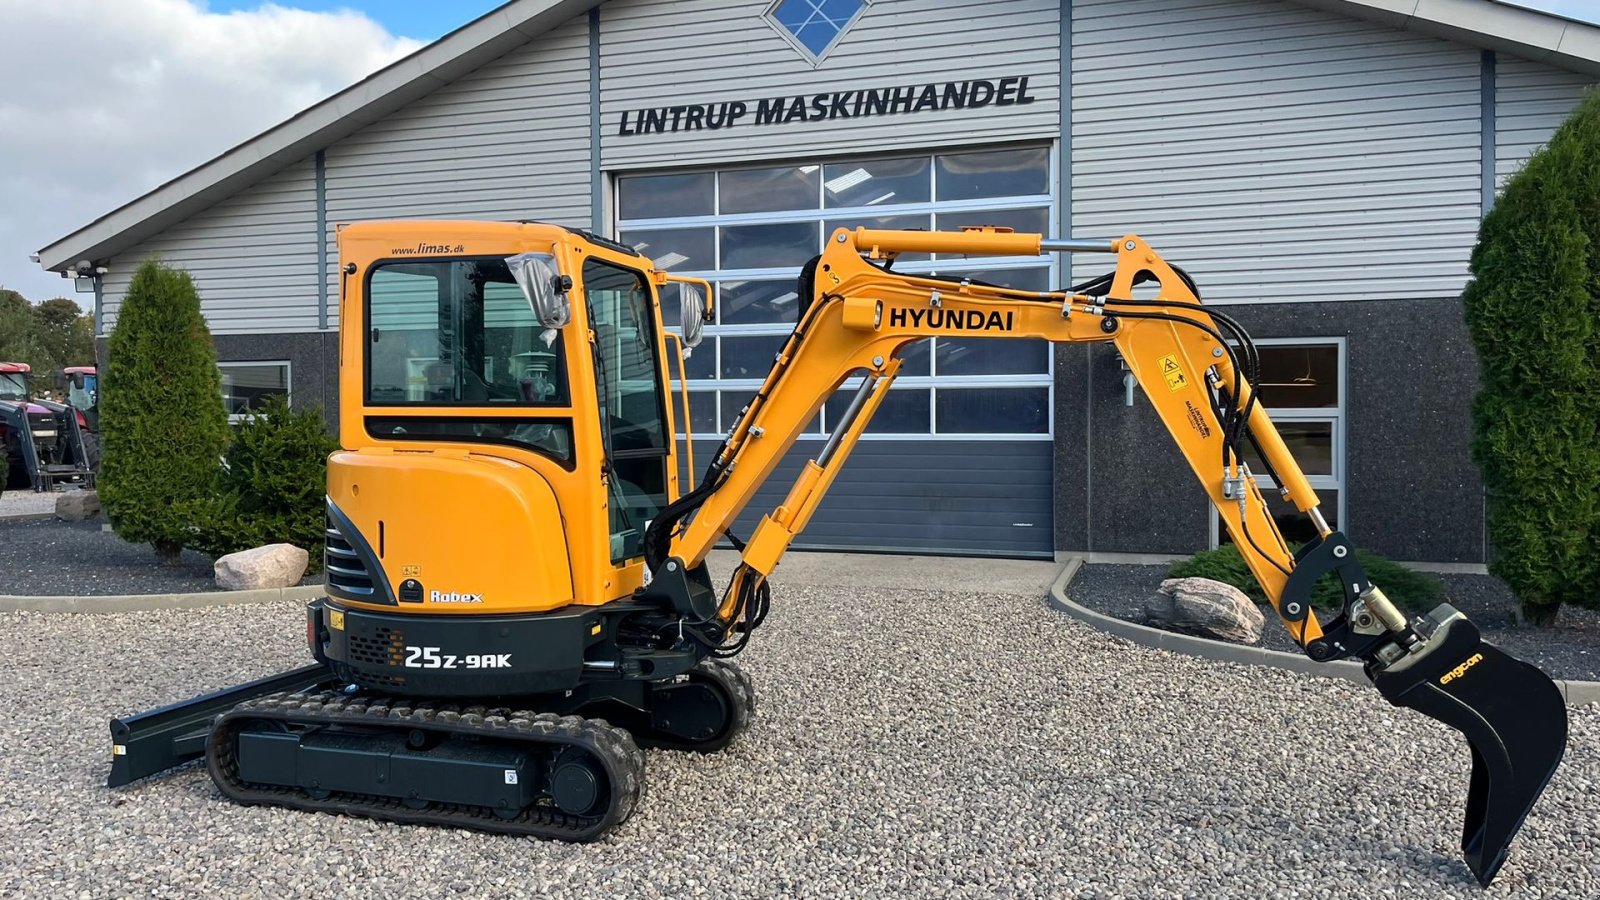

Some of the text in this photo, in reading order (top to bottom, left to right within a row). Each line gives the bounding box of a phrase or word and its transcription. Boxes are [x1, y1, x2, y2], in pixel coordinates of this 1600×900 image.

[618, 76, 1035, 136] LINTRUP MASKINHANDEL
[391, 242, 465, 255] www.limas.dk
[890, 307, 1014, 331] HYUNDAI
[430, 590, 484, 603] Robex
[1440, 653, 1483, 684] engcon
